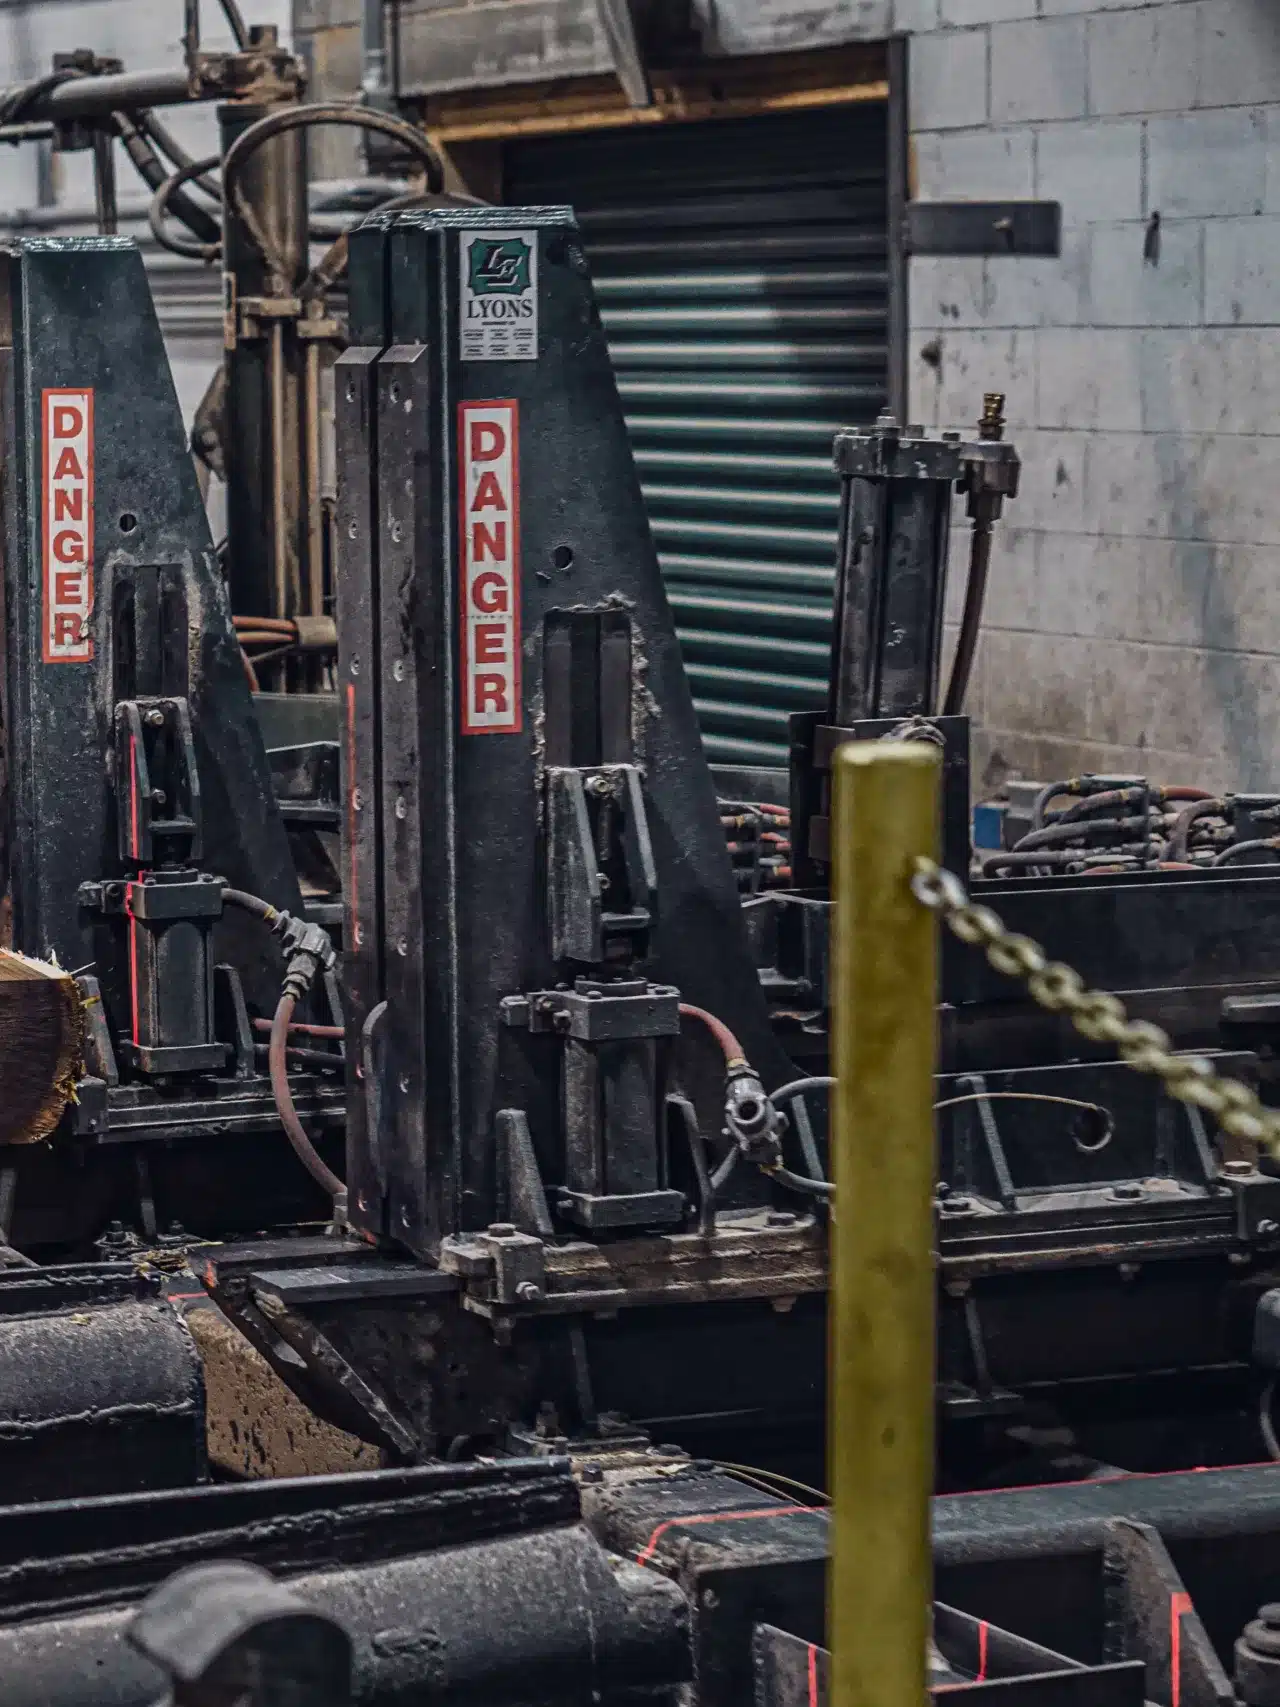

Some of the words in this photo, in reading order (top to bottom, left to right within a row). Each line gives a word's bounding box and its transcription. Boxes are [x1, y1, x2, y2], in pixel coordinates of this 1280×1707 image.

[466, 299, 534, 319] LYONS
[52, 405, 85, 646] DANGER
[470, 421, 509, 714] DANGER
